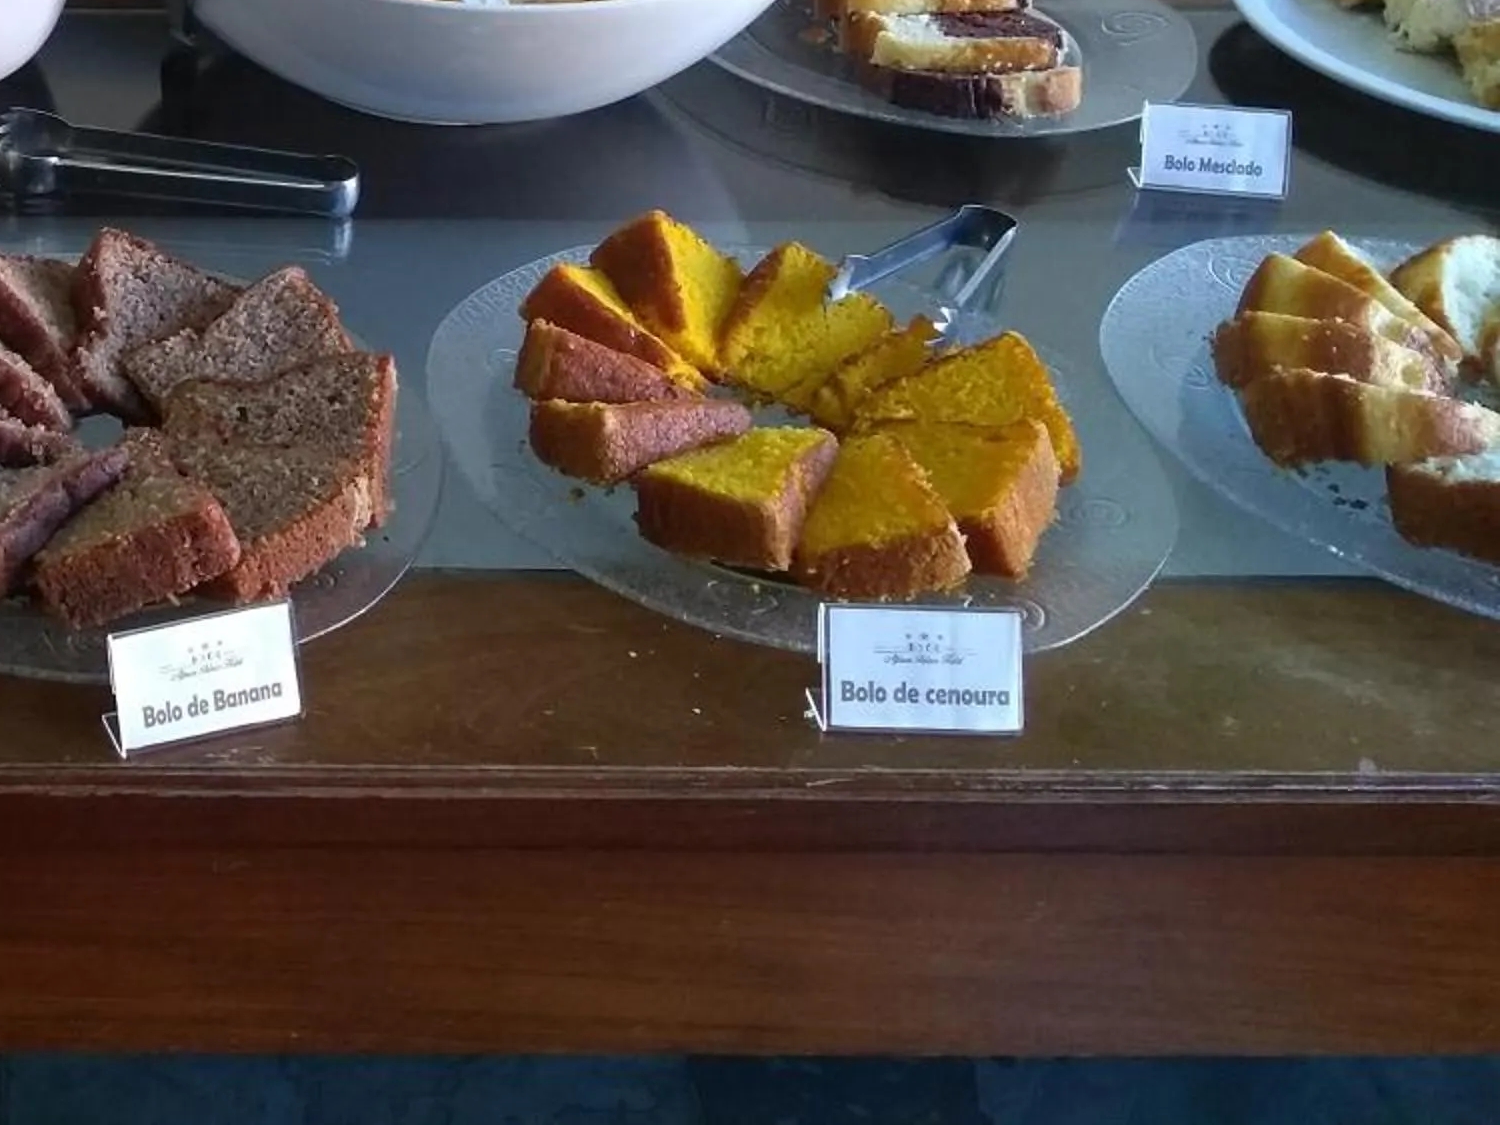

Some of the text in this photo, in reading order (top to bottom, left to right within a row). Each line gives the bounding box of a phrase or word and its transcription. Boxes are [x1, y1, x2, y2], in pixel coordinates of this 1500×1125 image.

[1164, 154, 1263, 177] Bolo Mesclado
[141, 681, 283, 729] Bolo de Banana
[840, 679, 1011, 706] Bolo de cenoura
